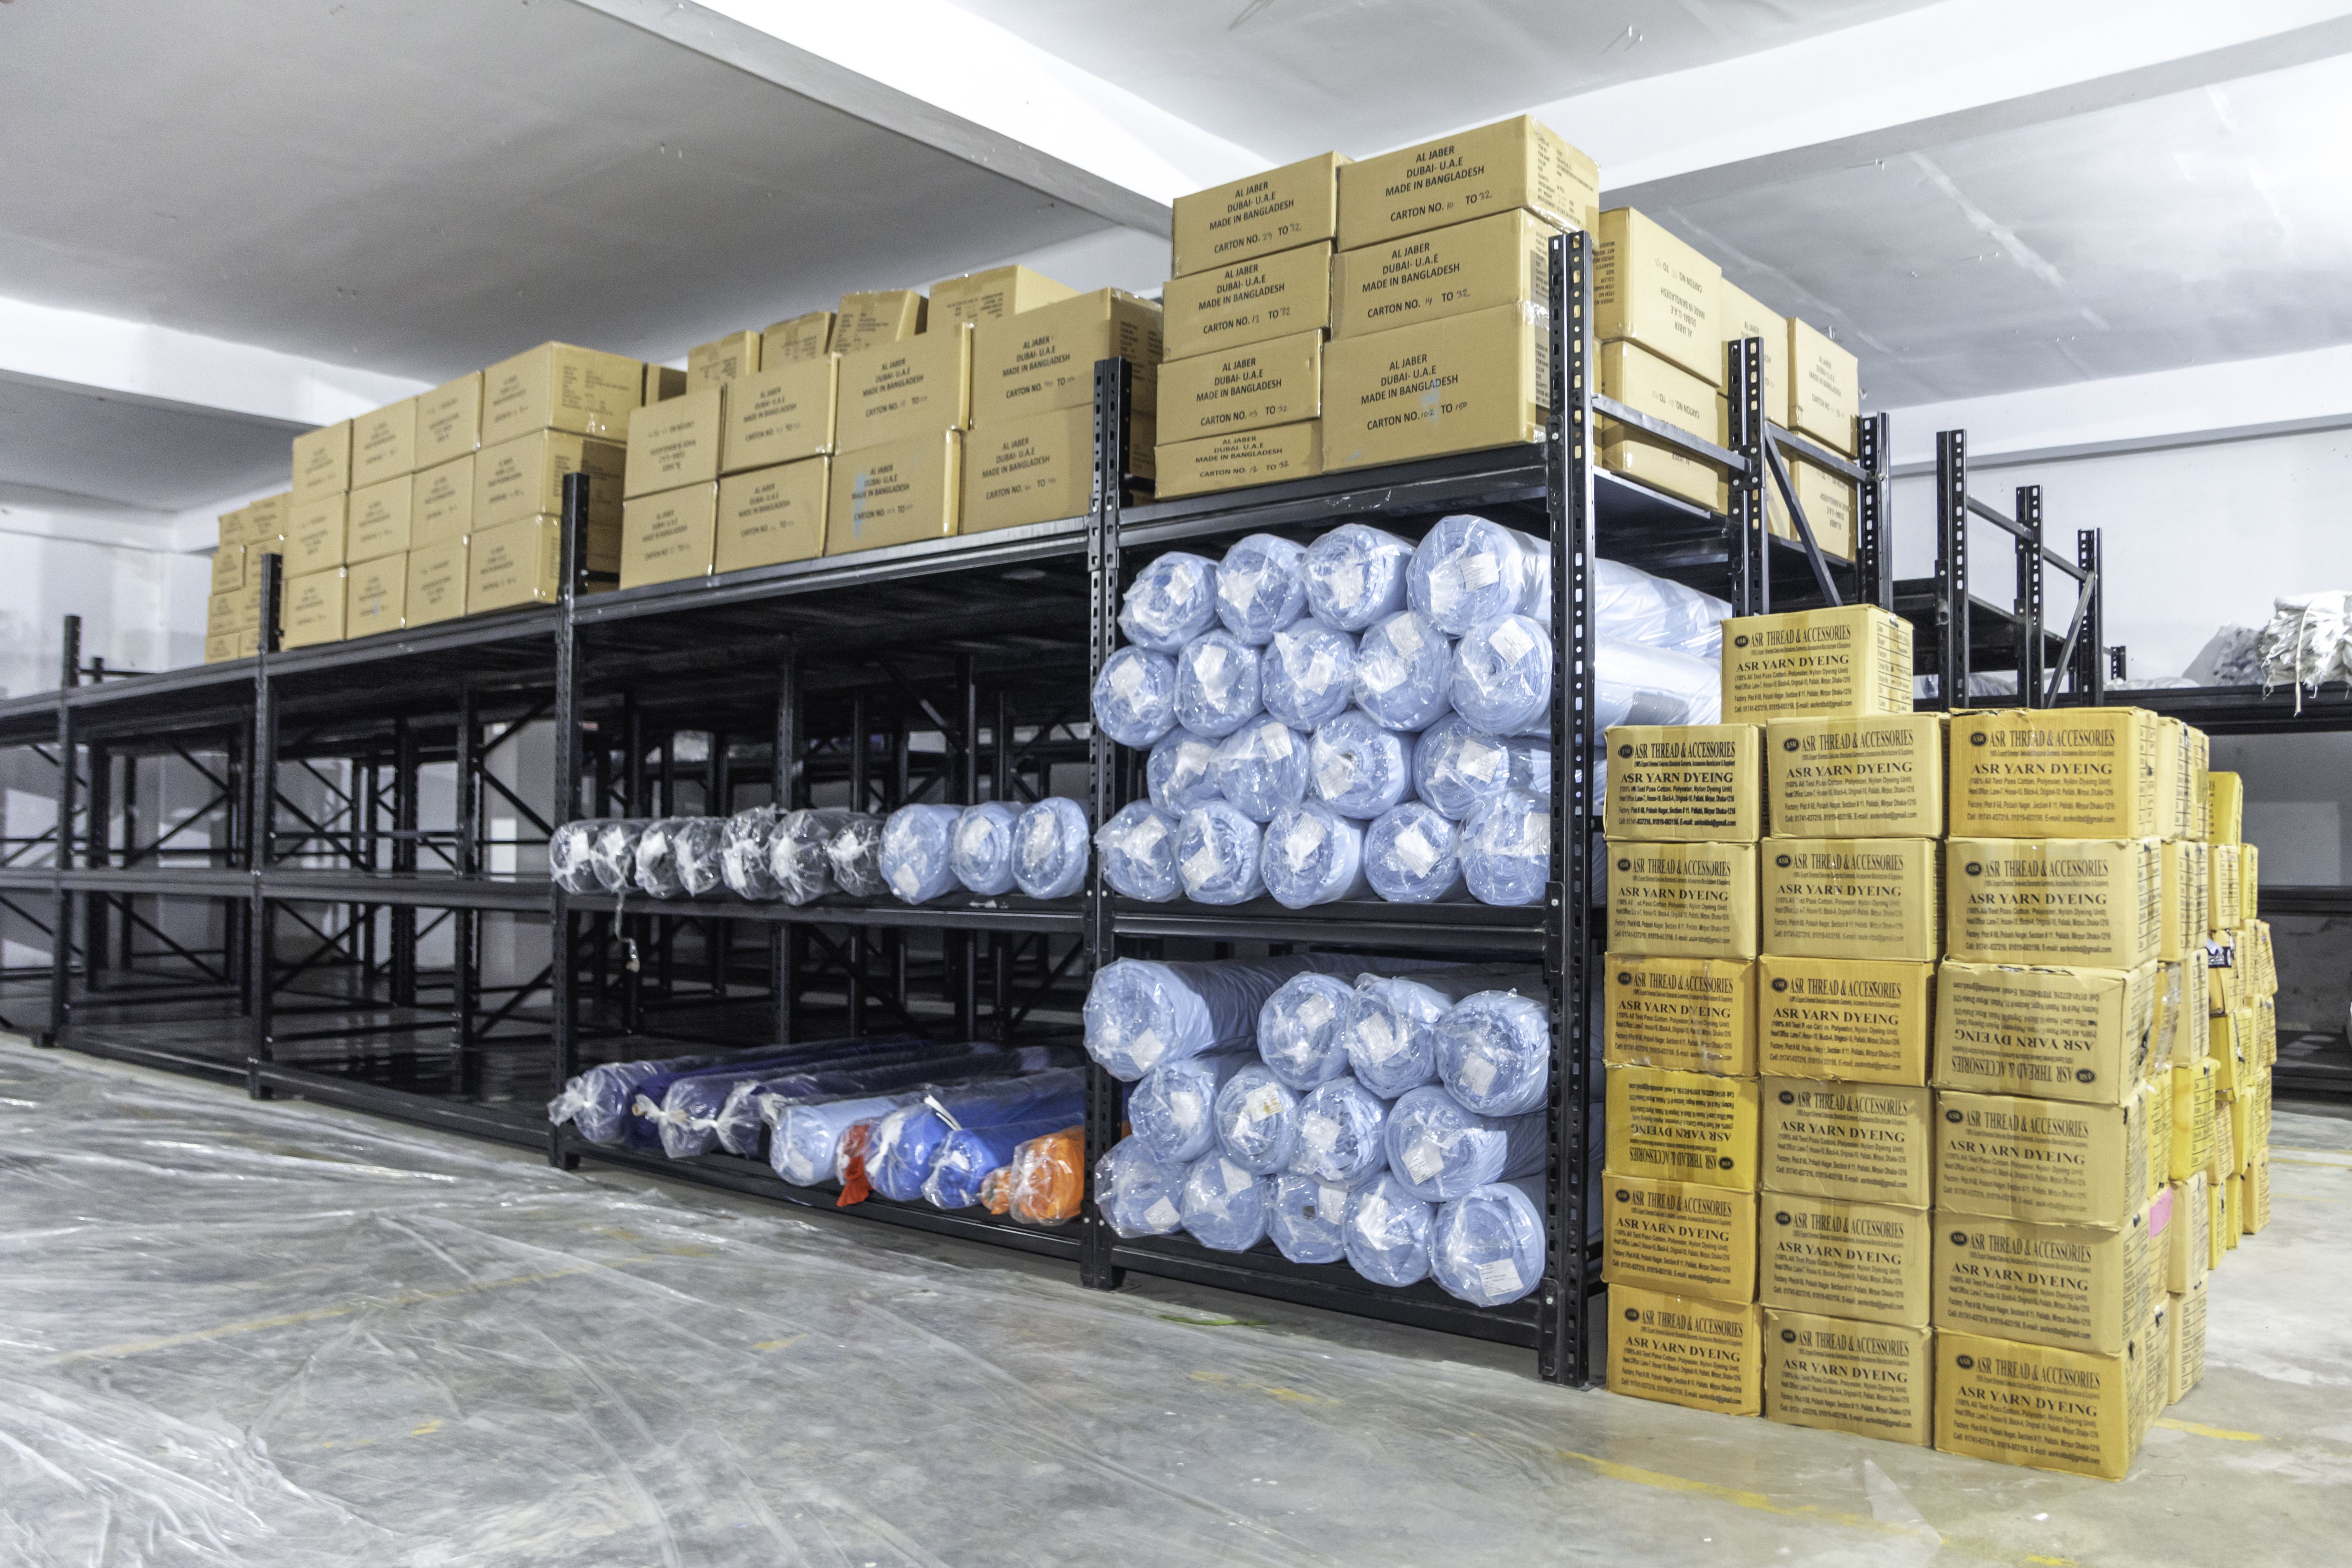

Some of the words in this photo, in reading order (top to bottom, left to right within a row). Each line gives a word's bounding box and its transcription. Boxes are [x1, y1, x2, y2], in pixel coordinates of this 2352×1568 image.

[1415, 152, 1426, 163] AL
[1428, 145, 1454, 160] JABER
[1385, 182, 1411, 197] MADE
[1413, 179, 1422, 190] IN
[1425, 164, 1484, 187] BANGLADESH
[1235, 188, 1244, 199] AL
[1246, 181, 1268, 195] JABER
[1209, 216, 1231, 230] MADE
[1233, 214, 1241, 224] IN
[1244, 198, 1293, 221] BANGLADESH
[1390, 205, 1425, 222] CARTON
[1428, 201, 1444, 214] NO.
[1465, 193, 1477, 205] TO
[1479, 190, 1493, 200] 32
[1214, 237, 1244, 254] CARTON
[1246, 233, 1260, 245] NO.
[1278, 225, 1288, 236] TO
[1663, 263, 1669, 273] TO
[1687, 276, 1702, 293] CARTON
[1661, 286, 1688, 309] BANGLADESH
[1689, 303, 1693, 312] IN
[1694, 305, 1705, 320] MADE
[1675, 321, 1686, 334] JABER
[1688, 328, 1692, 338] AL
[1023, 340, 1030, 350] AL
[1031, 335, 1049, 347] JABER
[1002, 366, 1020, 377] MADE
[1021, 364, 1028, 373] IN
[1029, 353, 1070, 370] BANGLADESH
[1389, 359, 1399, 371] AL
[1401, 353, 1427, 368] JABER
[1006, 385, 1030, 399] CARTON
[1031, 383, 1042, 392] NO.
[1056, 377, 1065, 387] TO
[1361, 390, 1385, 405] MADE
[1388, 388, 1397, 399] IN
[1400, 373, 1458, 396] BANGLADESH
[1367, 414, 1401, 430] CARTON
[1404, 410, 1420, 423] NO.
[1421, 409, 1435, 418] 102
[1440, 403, 1452, 415] TO
[1455, 401, 1467, 411] 150
[1230, 448, 1282, 459] BANGLADESH
[1199, 469, 1230, 477] CARTON
[1750, 631, 1763, 648] ASR
[1766, 629, 1794, 646] THREAD
[1795, 628, 1801, 643] &
[1802, 623, 1851, 643] ACCESSORIES
[1736, 661, 1759, 672] ASR
[1762, 658, 1796, 670] YARN
[1799, 653, 1849, 667] DYEING
[1990, 730, 2006, 747] ASR
[2009, 730, 2045, 747] THREAD
[2046, 730, 2054, 746] &
[2055, 729, 2115, 746] ACCESSORIES
[1971, 763, 2000, 774] ASR
[2004, 763, 2045, 774] YARN
[2050, 763, 2112, 774] DYEING
[1790, 977, 1804, 994] ASR
[1807, 978, 1838, 996] THREAD
[1840, 979, 1846, 996] &
[1847, 979, 1901, 999] ACCESSORIES
[1773, 1007, 1799, 1019] ASR
[1802, 1009, 1839, 1021] YARN
[1843, 1011, 1899, 1025] DYEING
[1631, 1124, 1672, 1137] DYEING
[1676, 1128, 1706, 1140] YARN
[1709, 1131, 1731, 1143] ASR
[1629, 1146, 1669, 1166] ACCESSORIES
[1670, 1150, 1676, 1166] &
[1676, 1151, 1702, 1169] THREAD
[1705, 1154, 1717, 1171] ASR
[1793, 1211, 1807, 1229] ASR
[1810, 1213, 1841, 1233] THREAD
[1843, 1217, 1849, 1233] &
[1850, 1217, 1904, 1239] ACCESSORIES
[1777, 1240, 1802, 1253] ASR
[1805, 1244, 1842, 1258] YARN
[1846, 1249, 1901, 1265] DYEING
[1976, 1355, 1992, 1374] ASR
[1995, 1358, 2030, 1380] THREAD
[2032, 1364, 2039, 1381] &
[2040, 1364, 2100, 1391] ACCESSORIES
[1958, 1385, 1986, 1400] ASR
[1989, 1390, 2030, 1407] YARN
[2035, 1397, 2097, 1418] DYEING
